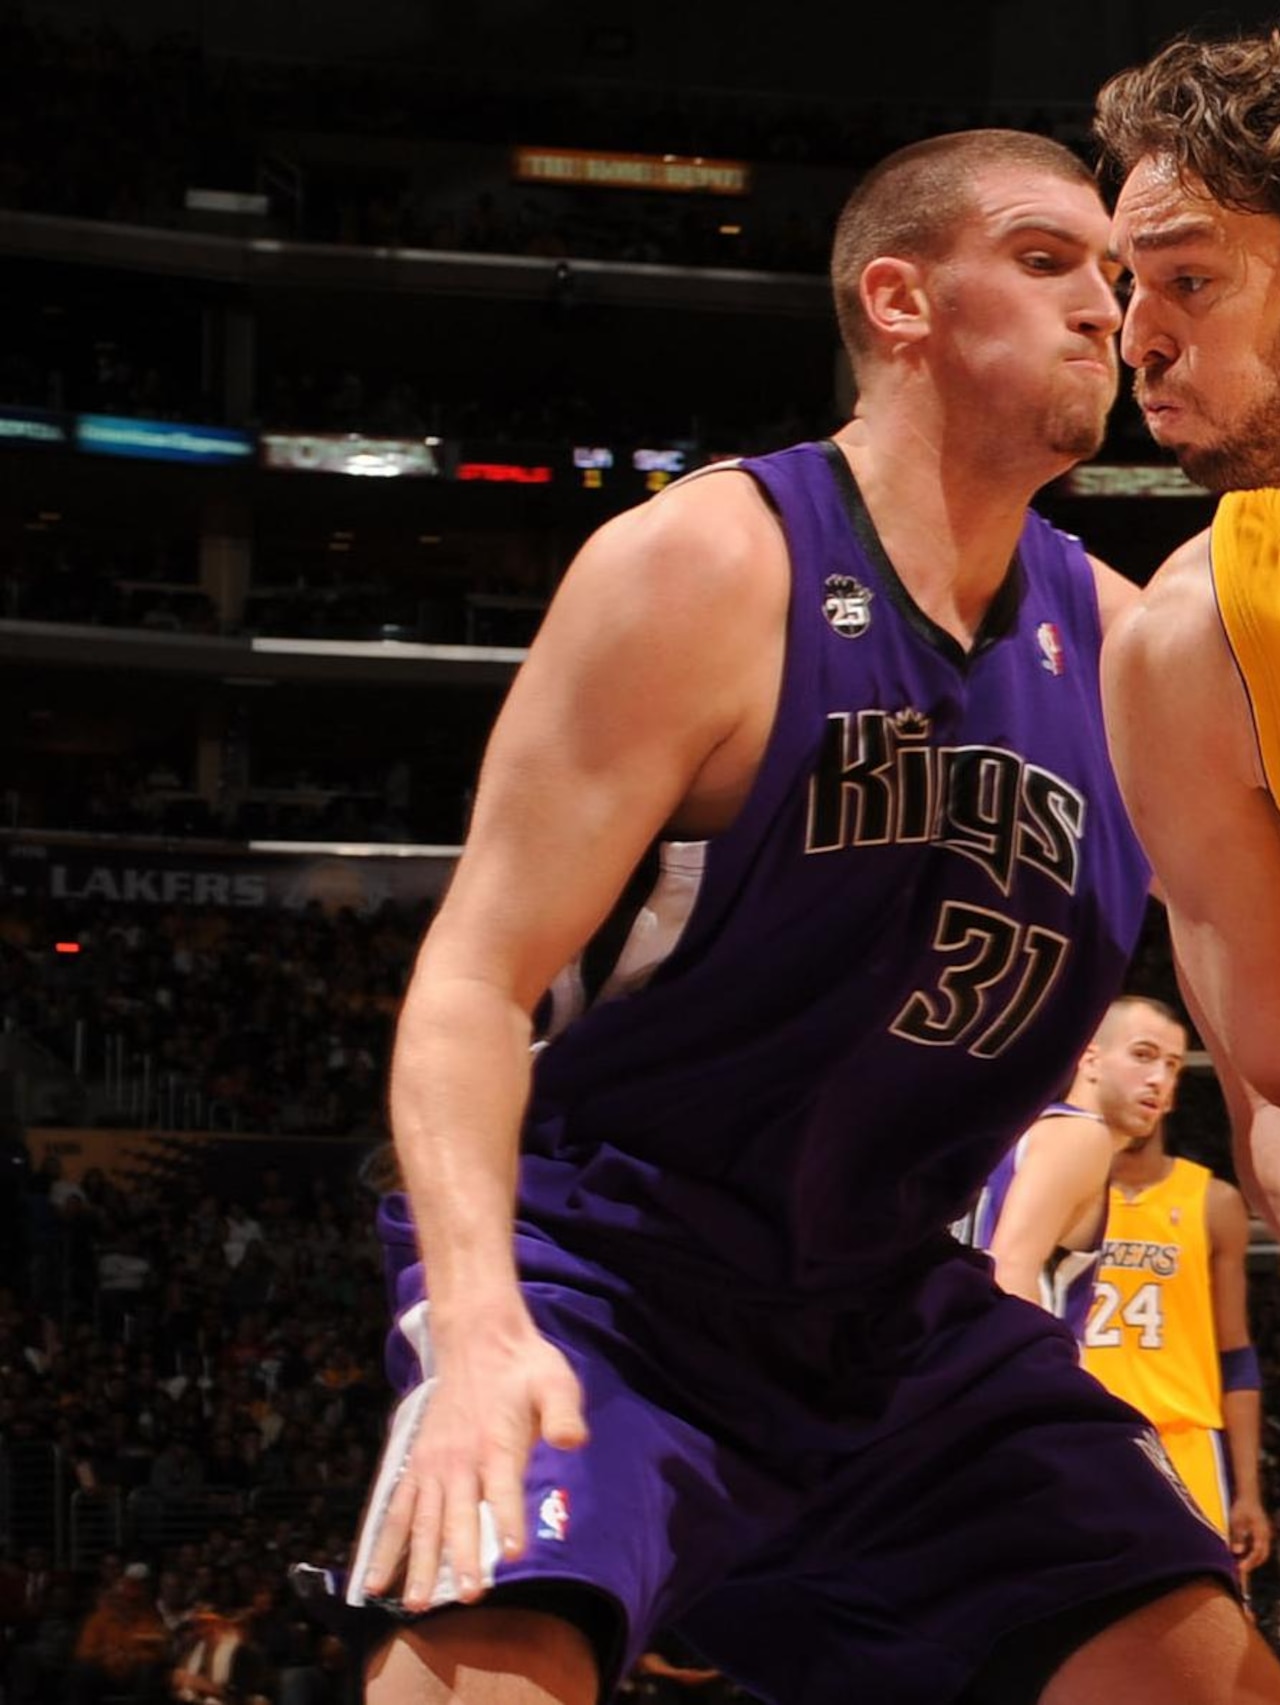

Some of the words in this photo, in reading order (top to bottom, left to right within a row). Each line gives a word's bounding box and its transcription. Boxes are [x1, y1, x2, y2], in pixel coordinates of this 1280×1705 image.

[825, 597, 867, 627] 25
[804, 706, 1086, 897] Kigs
[49, 865, 267, 908] LAKERS
[887, 900, 1072, 1060] 31
[1085, 1282, 1163, 1349] 24
